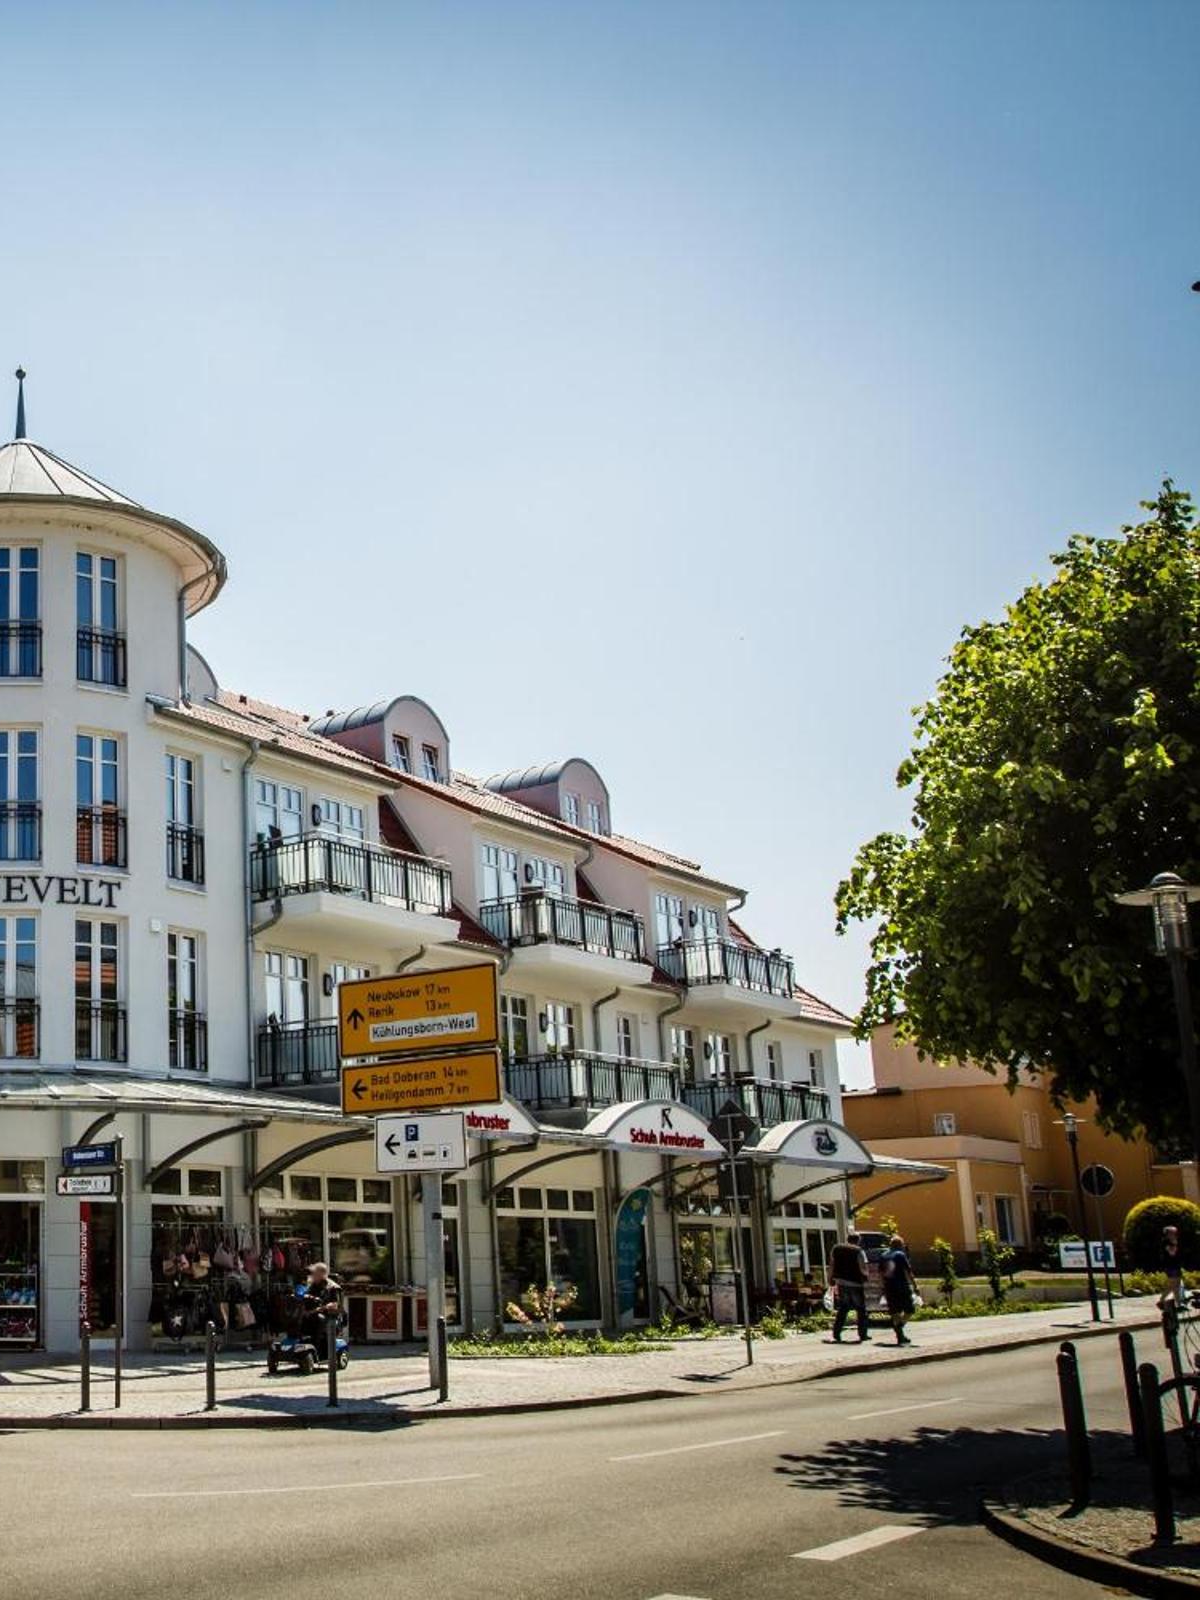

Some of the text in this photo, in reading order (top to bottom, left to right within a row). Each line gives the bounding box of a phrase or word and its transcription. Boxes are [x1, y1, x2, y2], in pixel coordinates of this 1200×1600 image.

[425, 984, 434, 994] 17
[369, 1006, 394, 1017] Rerik
[425, 1000, 435, 1011] 13
[372, 1018, 475, 1037] Kühlungsborn-West
[371, 1073, 389, 1085] Bad
[393, 1070, 436, 1084] Doberan
[443, 1066, 453, 1077] 14
[371, 1086, 444, 1102] Heiligendamm
[448, 1083, 455, 1094] 7
[630, 1127, 705, 1148] Schuh Armbruster
